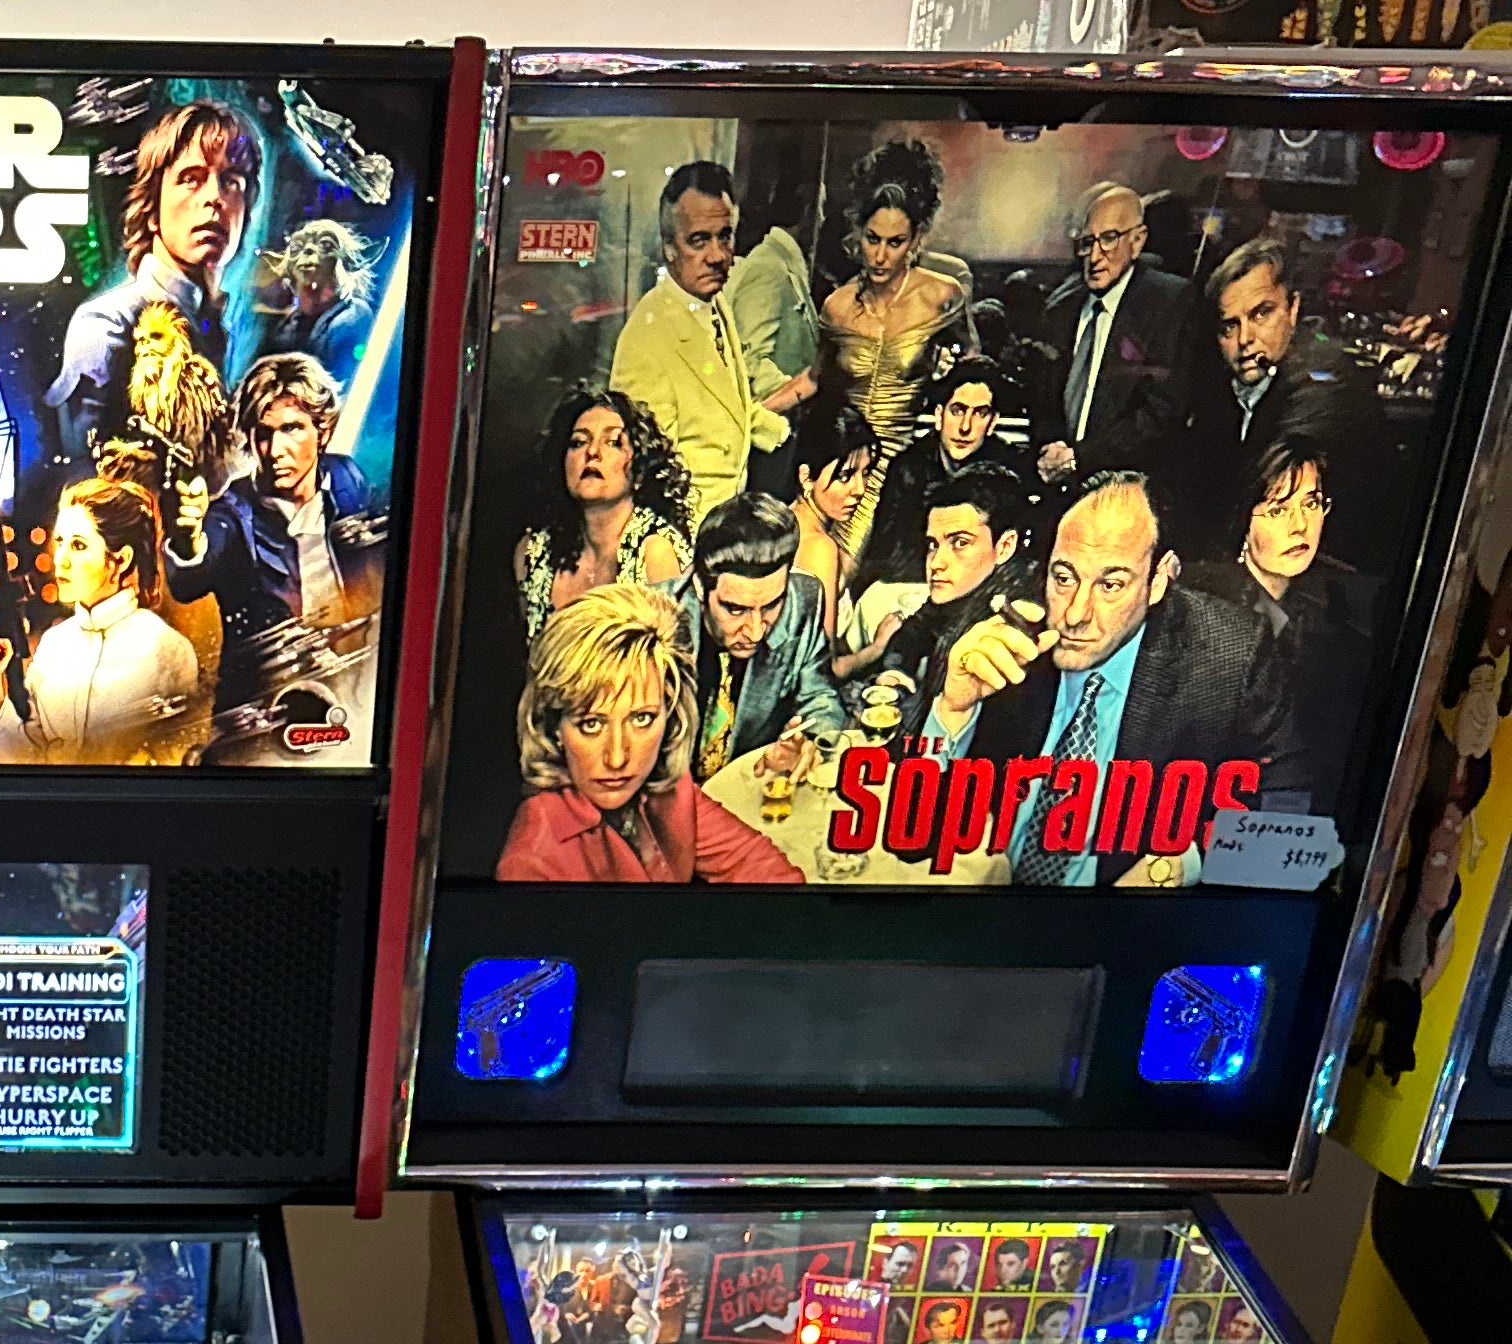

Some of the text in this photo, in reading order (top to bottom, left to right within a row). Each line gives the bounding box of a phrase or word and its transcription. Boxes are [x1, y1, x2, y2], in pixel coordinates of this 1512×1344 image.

[524, 150, 604, 186] HBO
[522, 224, 595, 247] STERN
[291, 729, 346, 745] Stern
[903, 736, 945, 754] THE
[828, 746, 1261, 874] Sopranos
[1236, 816, 1315, 838] Sopranos
[38, 945, 69, 954] YOUR
[71, 945, 101, 955] PATH
[17, 972, 125, 992] TRAINING
[22, 1008, 79, 1021] DEATH
[82, 1009, 126, 1022] STAR
[6, 1025, 86, 1040] MISSIONS
[29, 1057, 123, 1074] FIGHTERS
[70, 1109, 99, 1126] UP
[19, 1127, 52, 1136] RIGHT
[54, 1127, 93, 1136] FLIPPER
[720, 1263, 784, 1299] BADA
